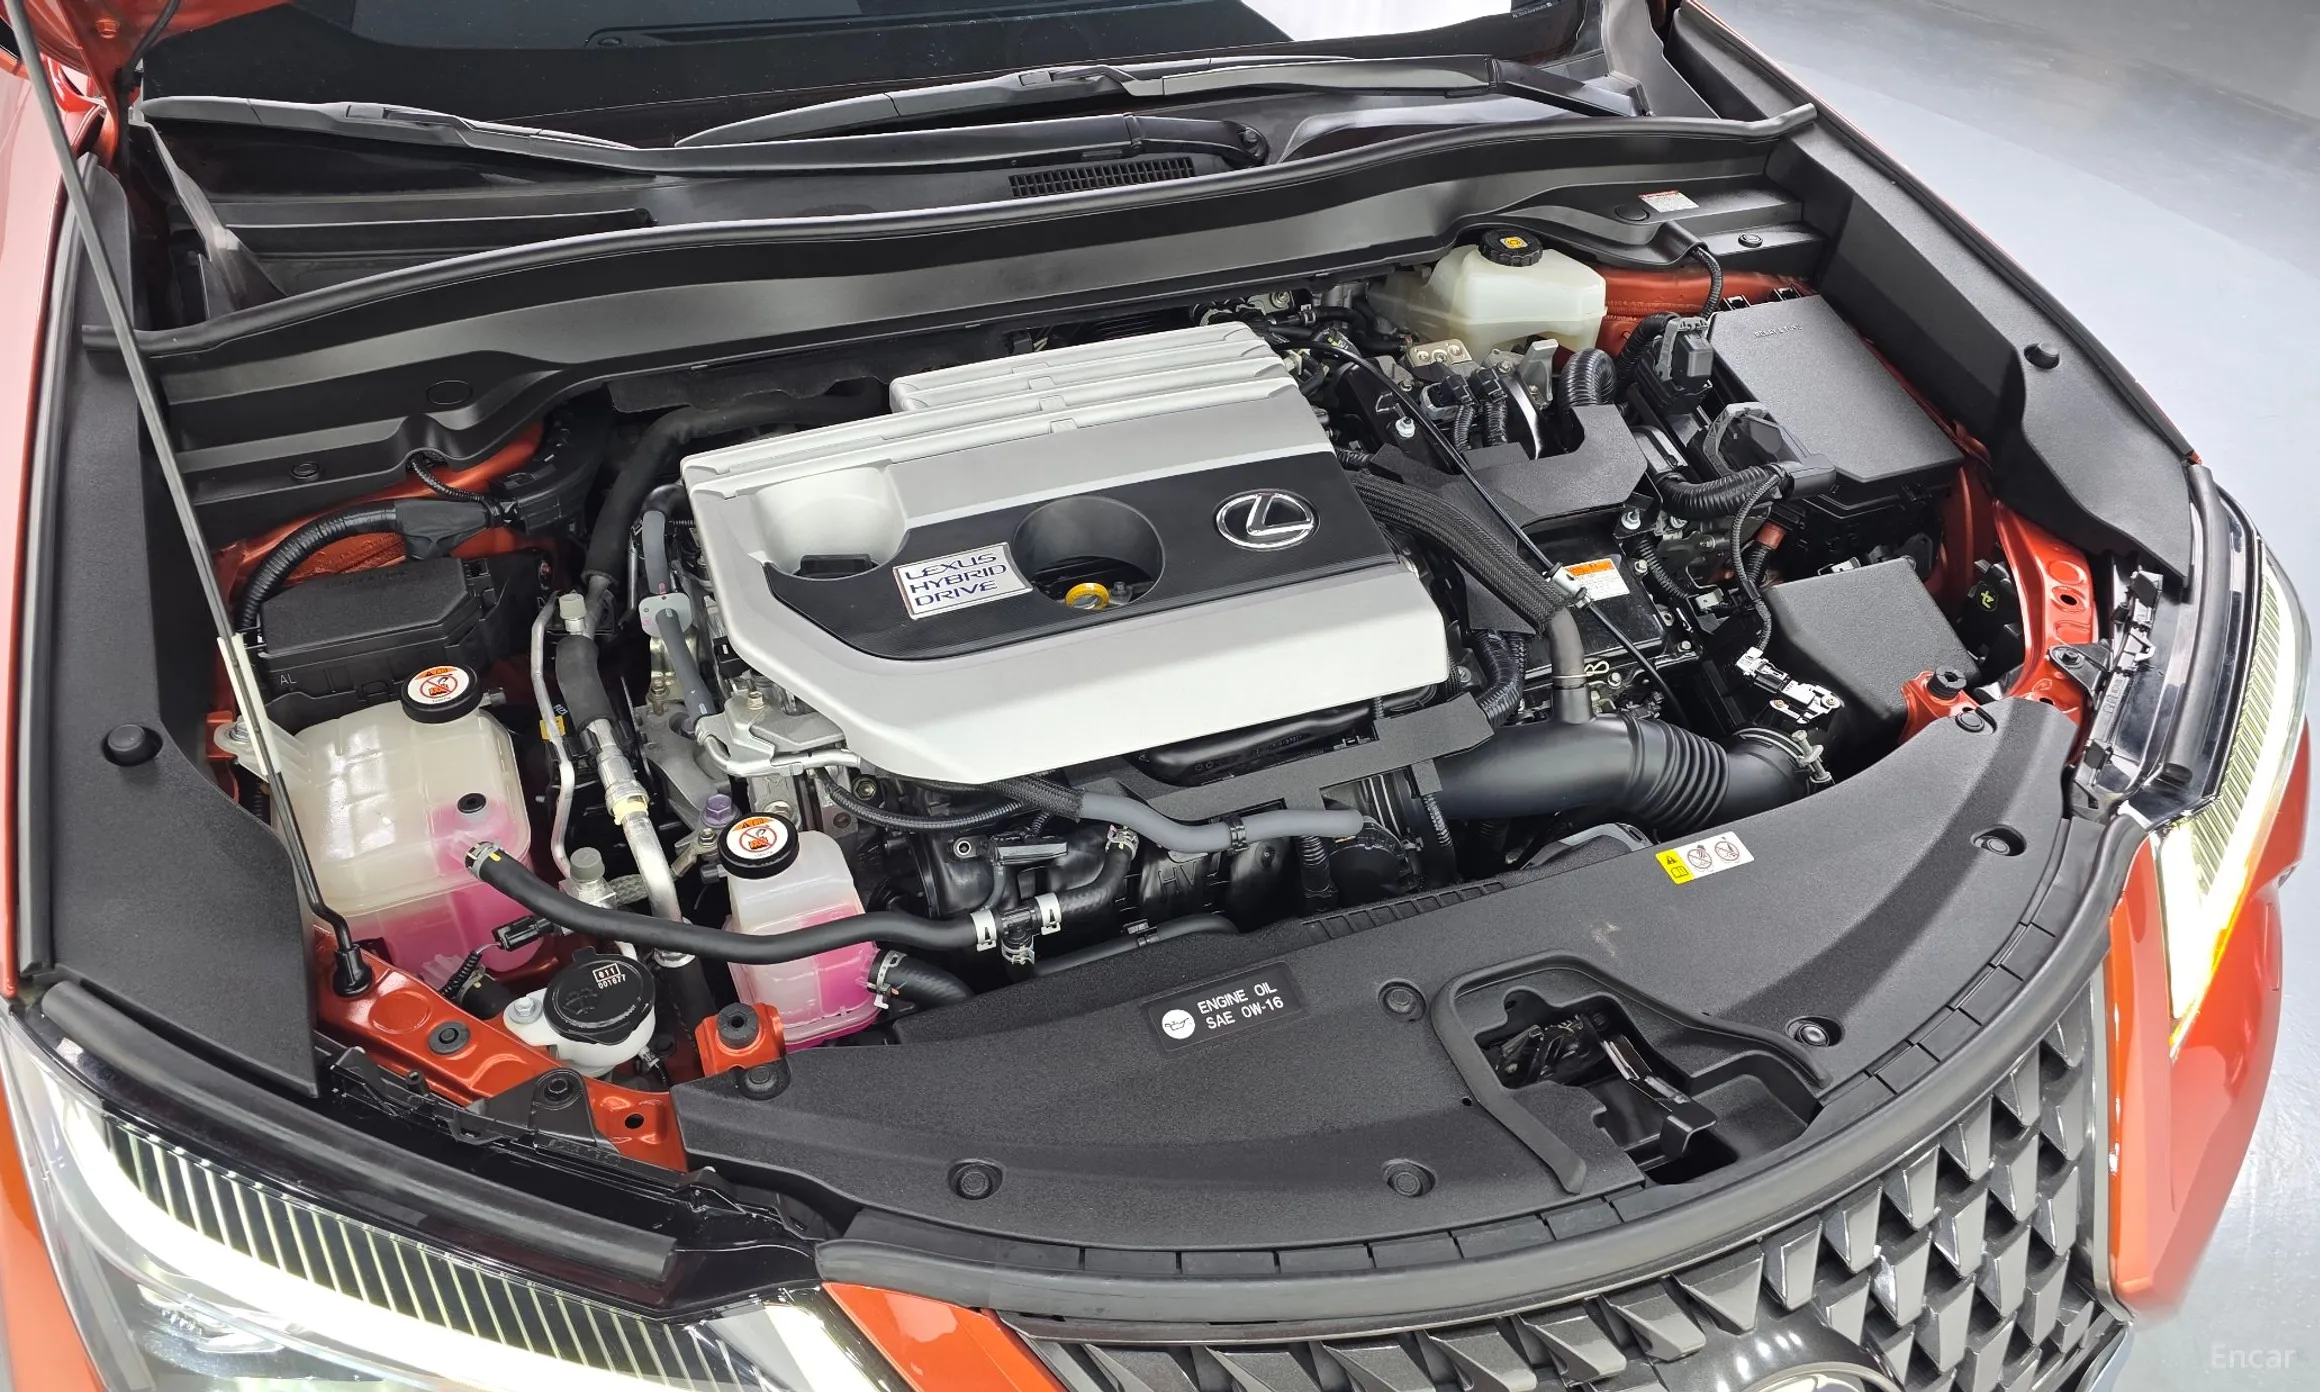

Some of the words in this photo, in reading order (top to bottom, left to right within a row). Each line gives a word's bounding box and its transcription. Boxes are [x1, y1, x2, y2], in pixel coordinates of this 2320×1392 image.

[904, 552, 998, 581] LEXUS
[909, 564, 1007, 594] HYBRID
[914, 580, 998, 607] DRIVE
[279, 673, 297, 687] AL
[1157, 860, 1197, 897] HV
[1196, 989, 1249, 1015] ENGINE
[1253, 981, 1278, 997] OIL
[1205, 1010, 1236, 1030] SAE
[1240, 995, 1285, 1019] 0W-16
